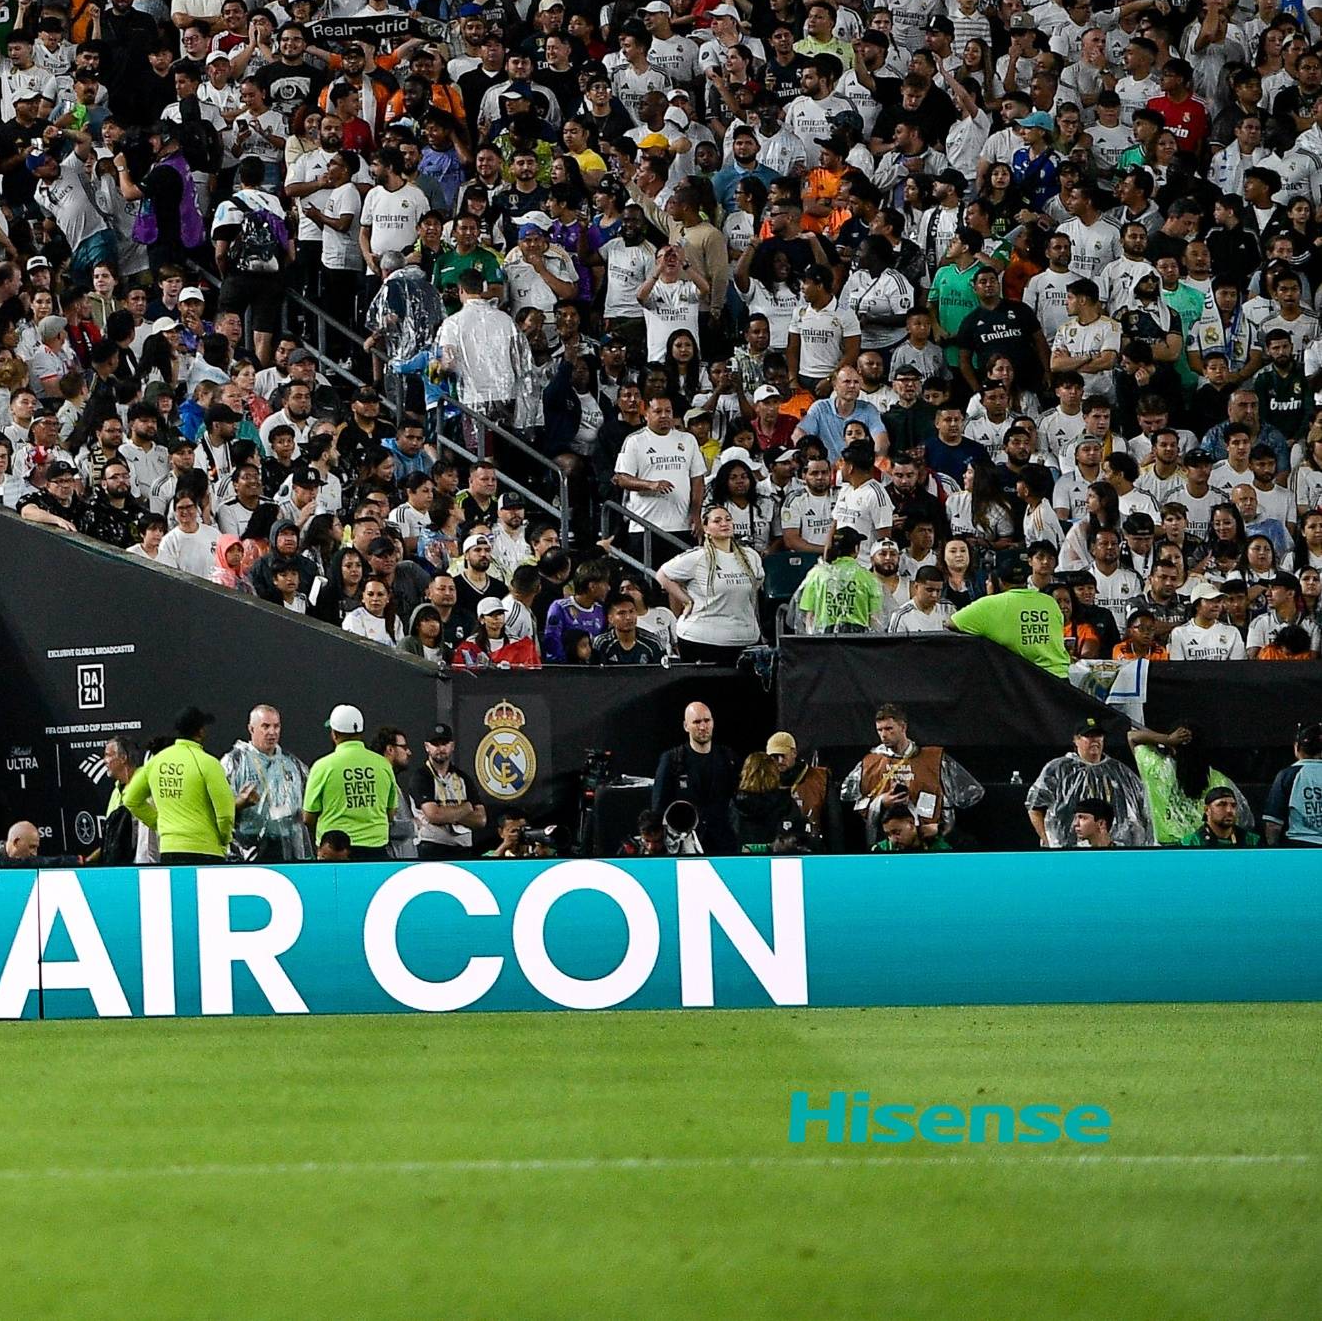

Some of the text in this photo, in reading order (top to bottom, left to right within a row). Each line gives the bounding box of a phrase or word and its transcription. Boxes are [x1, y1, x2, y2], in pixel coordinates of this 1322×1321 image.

[376, 214, 409, 222] Emirates
[981, 329, 1021, 342] Emirates
[1269, 399, 1301, 411] bwin
[650, 456, 686, 464] Emirates
[1020, 611, 1049, 623] CSC
[1021, 624, 1049, 636] EVENT
[1021, 635, 1050, 646] STAFF
[1188, 647, 1228, 656] Emirates
[6, 755, 39, 771] ULTRA
[159, 762, 185, 775] CSC
[343, 767, 375, 780] CSC
[159, 777, 184, 788] EVENT
[344, 781, 376, 795] EVENT
[160, 789, 184, 799] STAFF
[346, 796, 377, 809] STAFF
[362, 858, 808, 1010] CON
